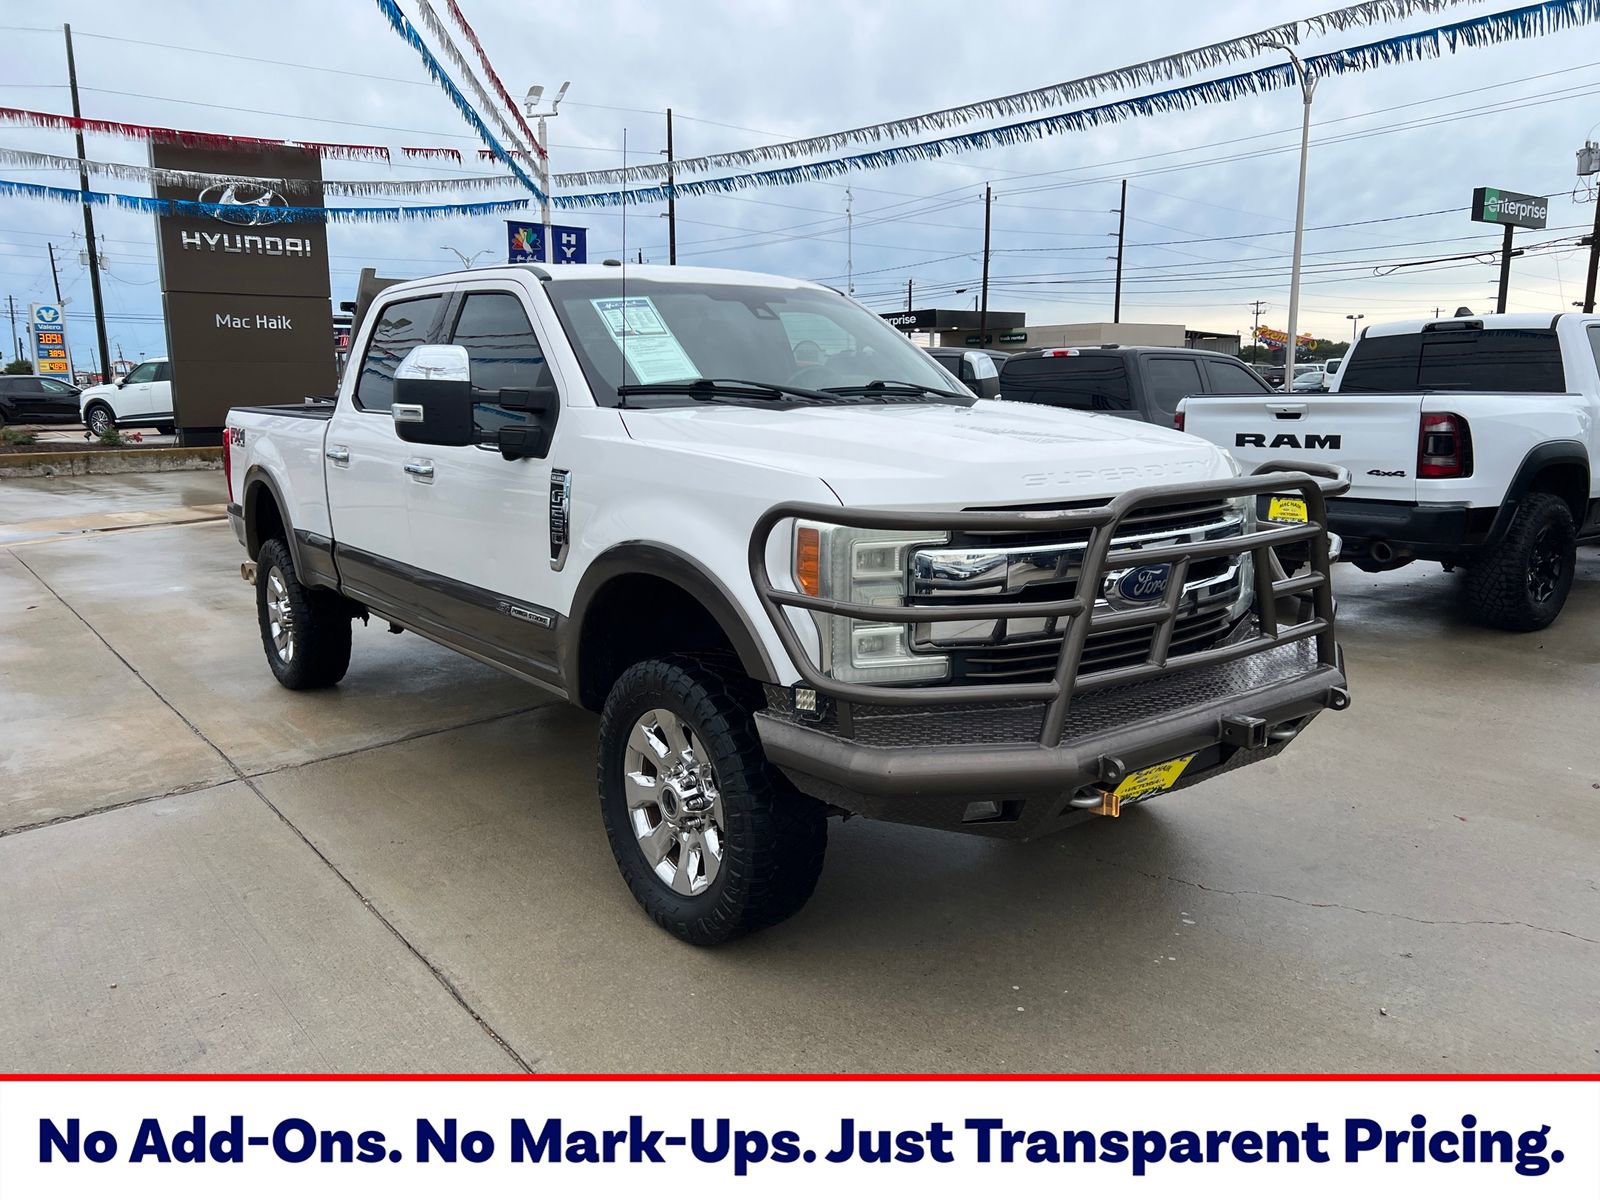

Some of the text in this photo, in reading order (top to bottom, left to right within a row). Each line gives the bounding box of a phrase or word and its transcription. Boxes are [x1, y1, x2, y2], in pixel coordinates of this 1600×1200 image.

[1485, 196, 1547, 221] enterprise
[181, 231, 311, 257] HYUNDAI
[215, 313, 293, 330] Mac Haik
[1235, 433, 1342, 450] RAM
[1021, 464, 1143, 487] SUPER
[1366, 469, 1407, 478] 4x4
